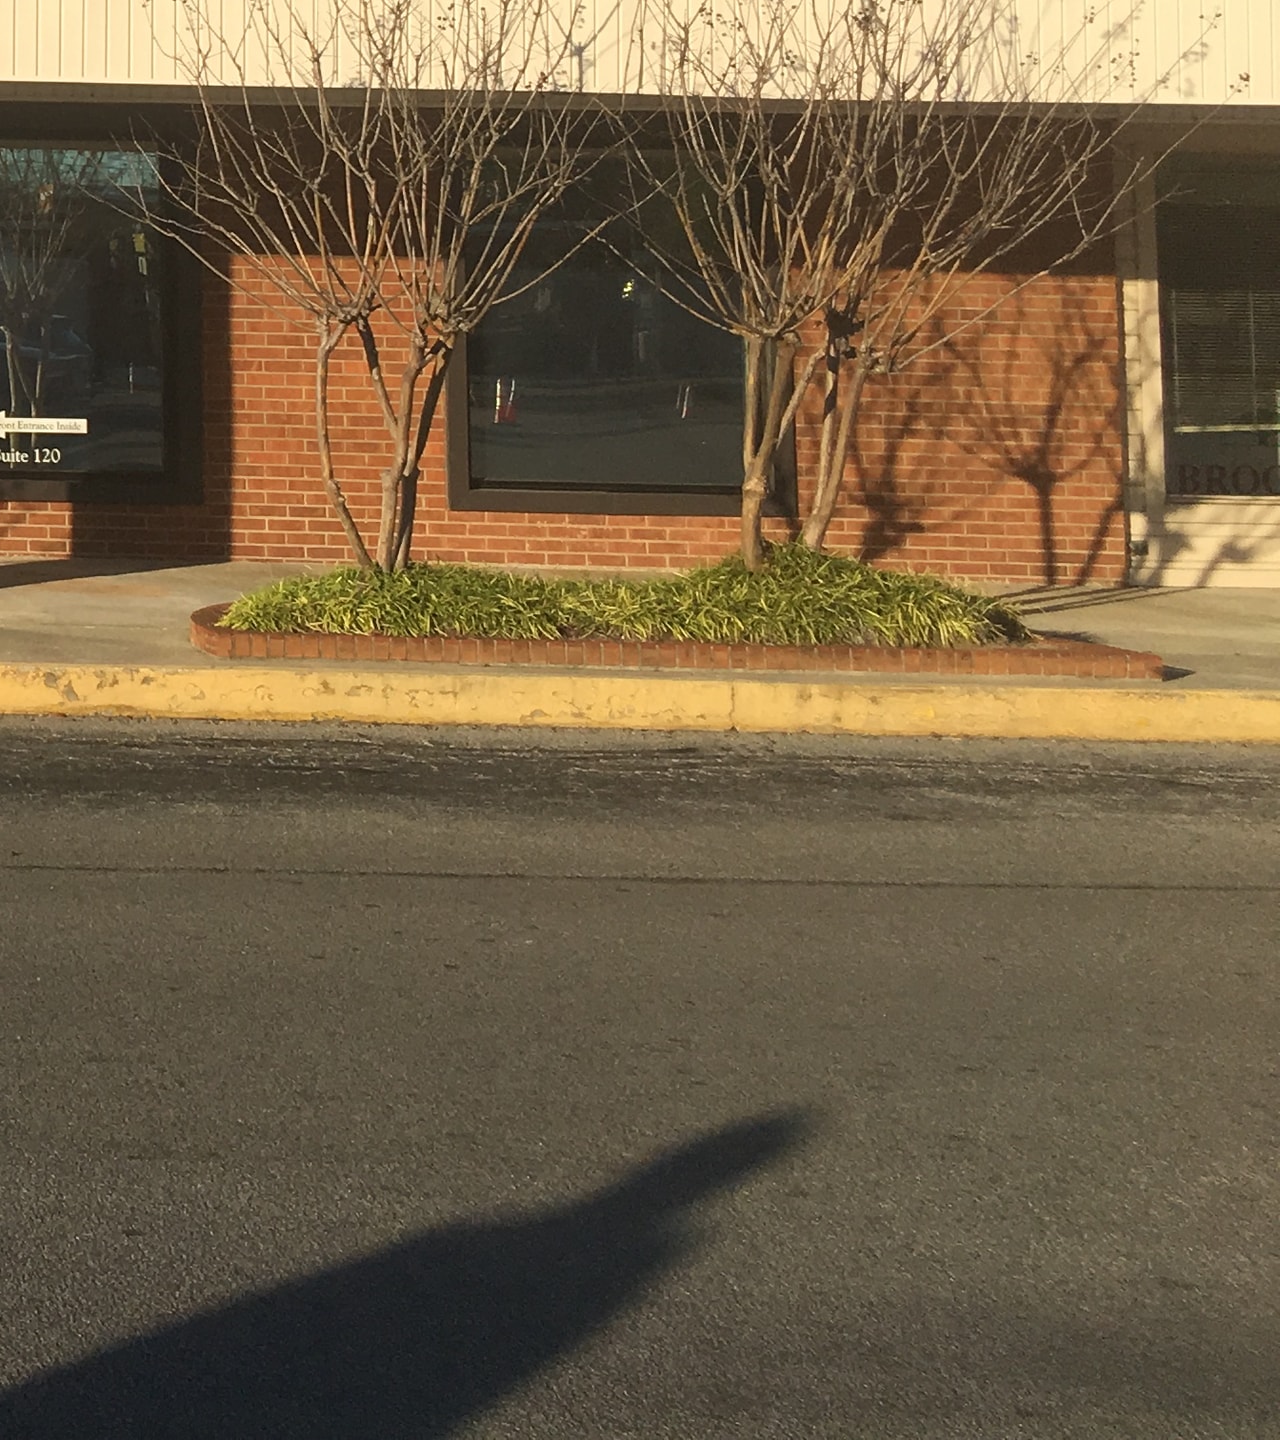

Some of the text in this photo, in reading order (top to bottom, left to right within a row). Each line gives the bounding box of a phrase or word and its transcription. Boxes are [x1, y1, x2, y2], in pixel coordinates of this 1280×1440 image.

[17, 420, 55, 431] Entrance
[56, 421, 82, 431] Inside
[33, 448, 61, 464] 120
